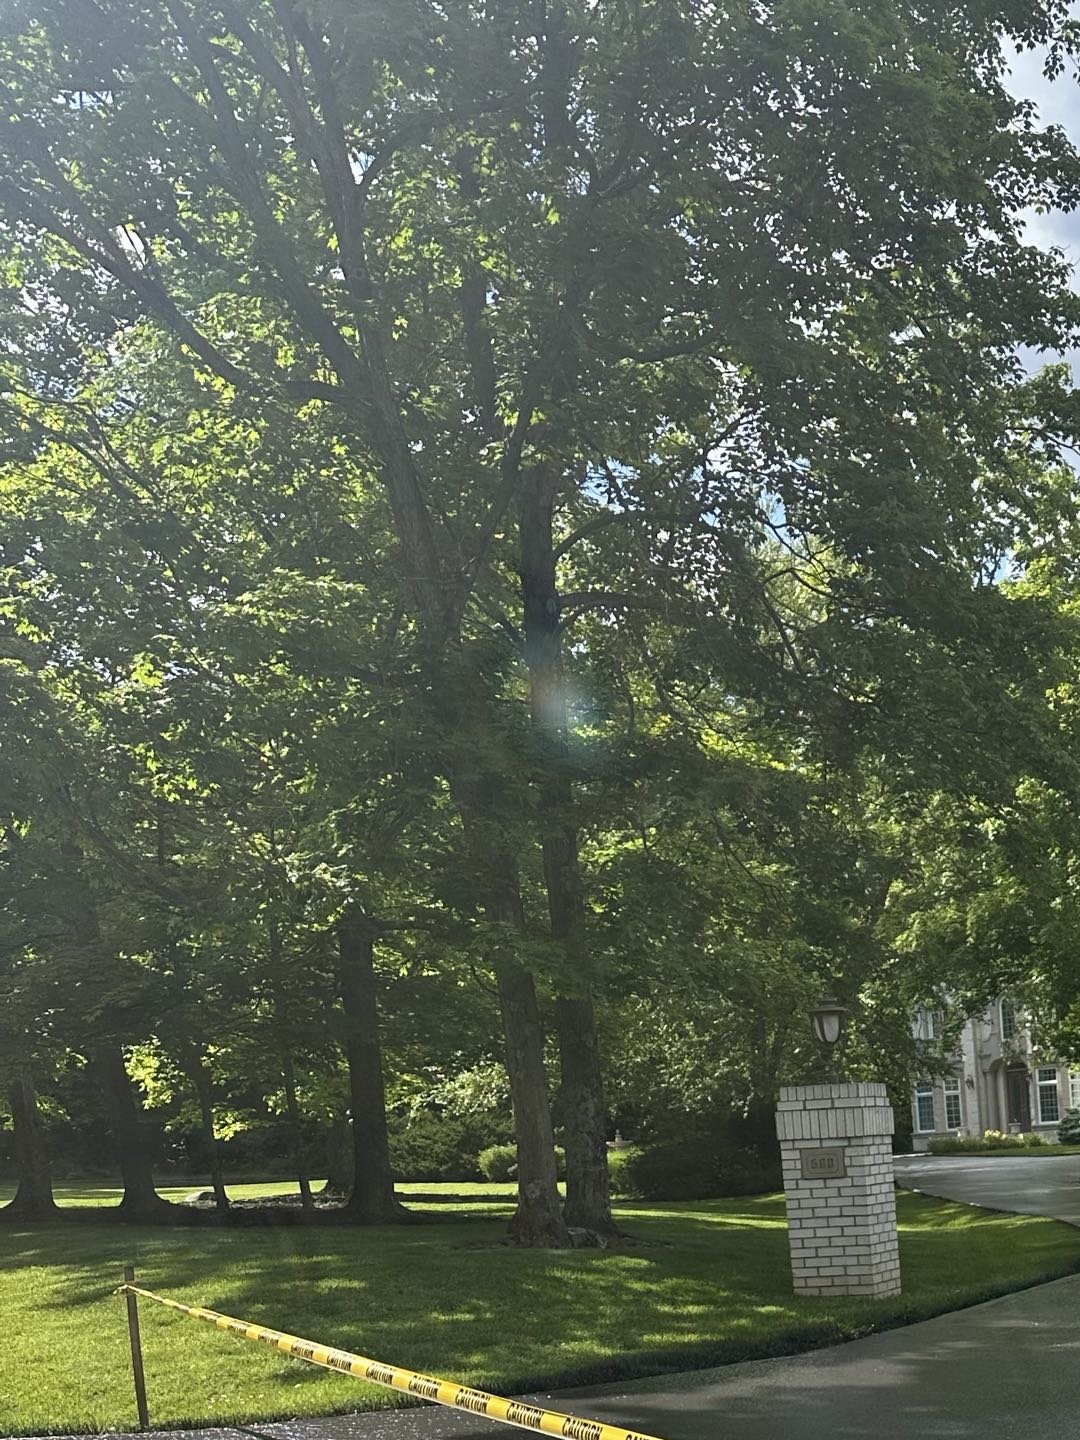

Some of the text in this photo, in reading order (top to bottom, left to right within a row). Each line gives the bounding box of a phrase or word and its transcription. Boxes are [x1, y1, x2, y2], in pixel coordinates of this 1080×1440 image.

[408, 1375, 441, 1399] CAUTION
[455, 1389, 490, 1415] CAUTION
[506, 1403, 544, 1429] CAUTION
